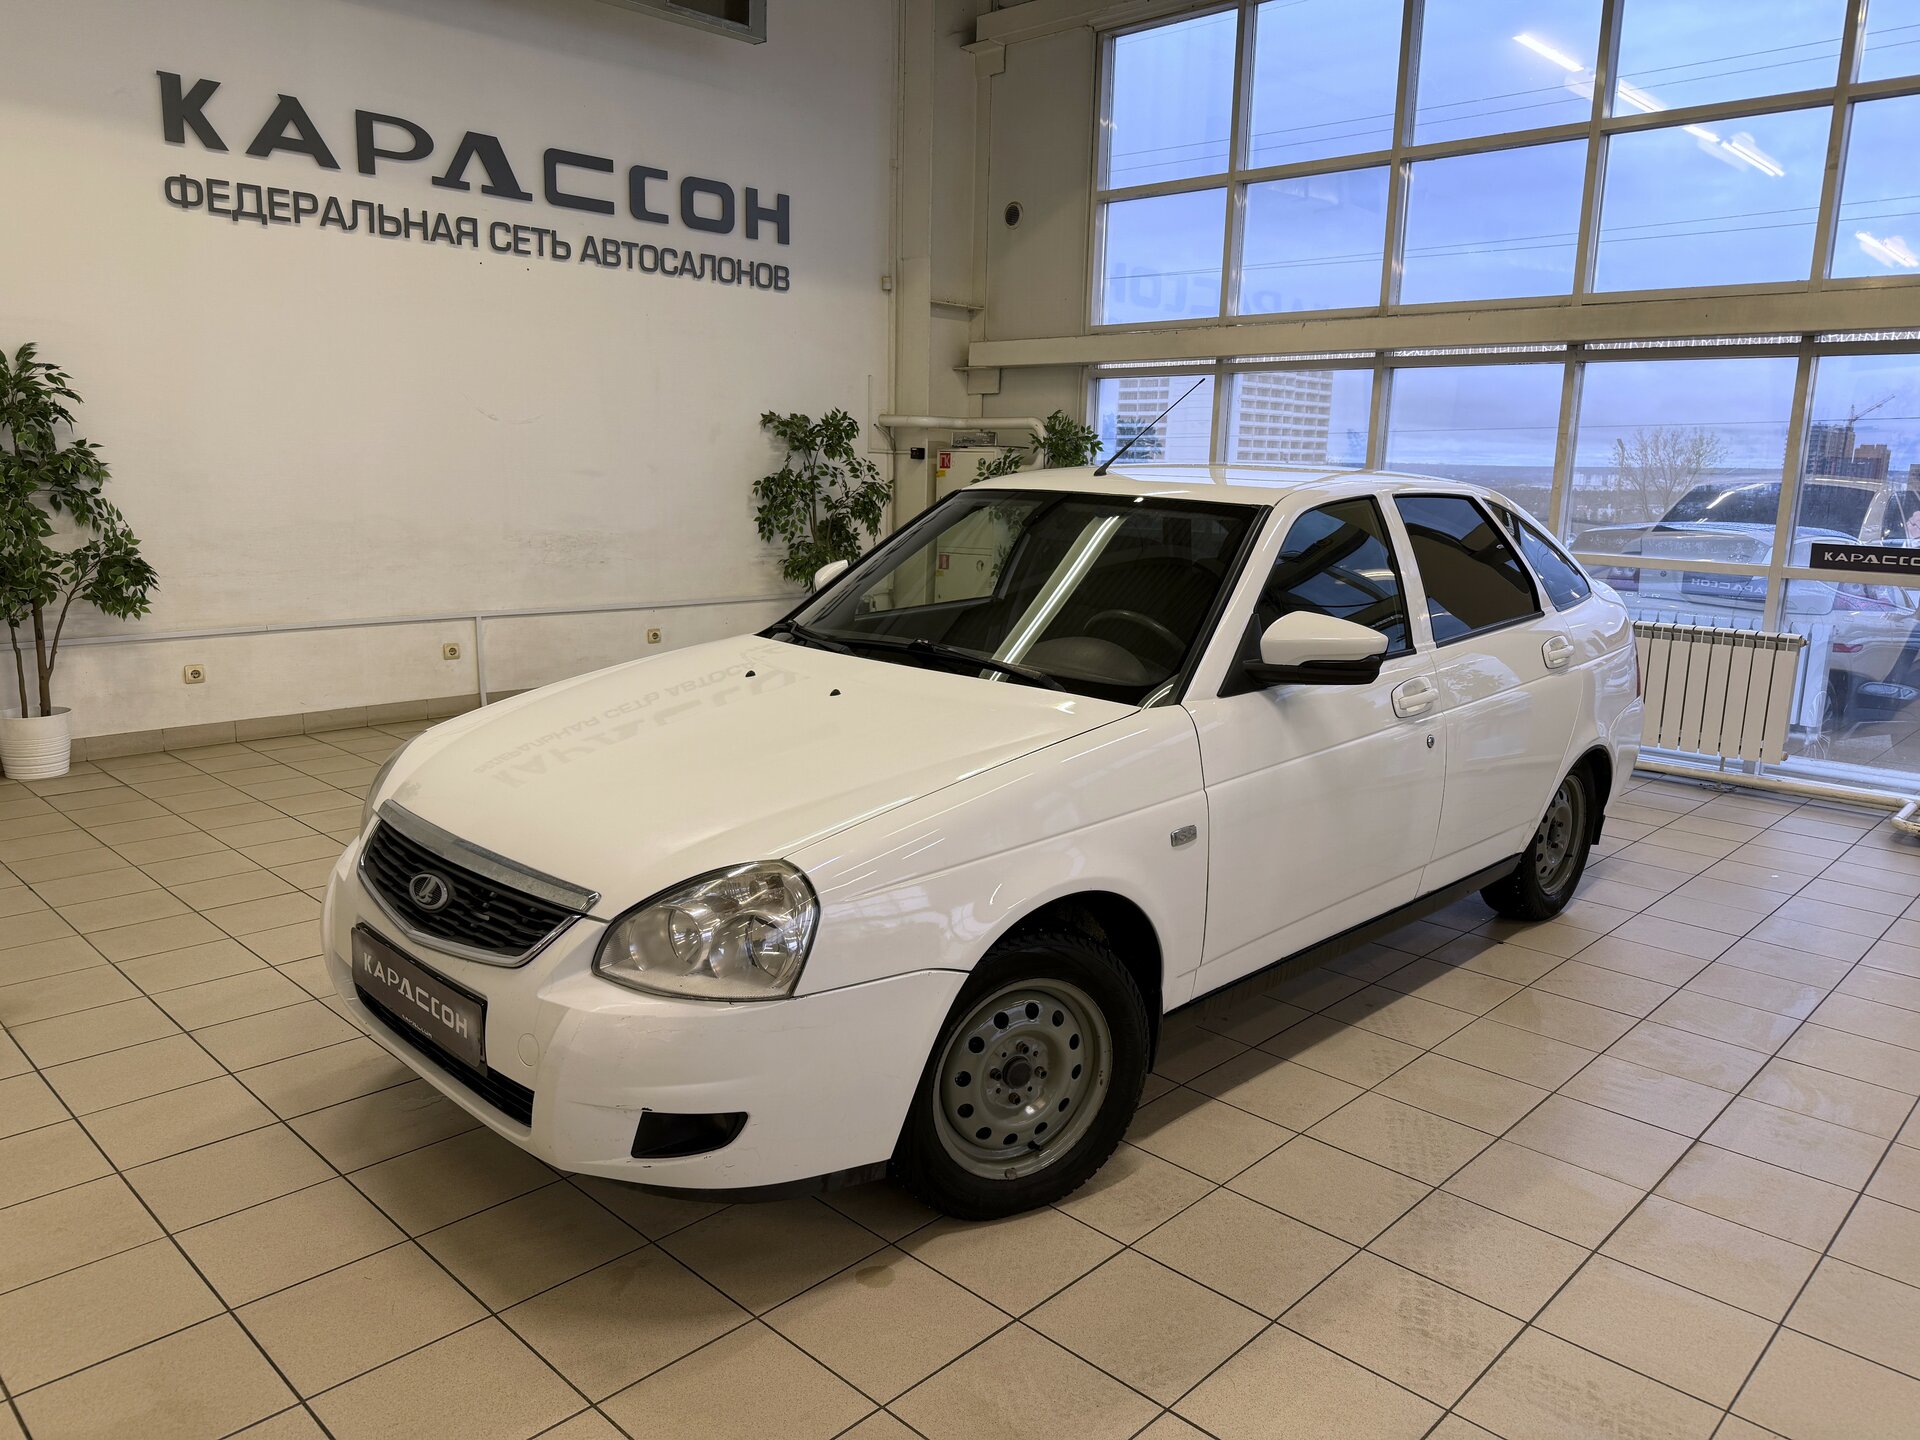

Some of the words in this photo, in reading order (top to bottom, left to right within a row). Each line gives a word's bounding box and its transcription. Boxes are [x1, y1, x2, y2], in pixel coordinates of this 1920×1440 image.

[164, 174, 479, 248] ФЕДЕРАЛЬНАЯ
[489, 221, 572, 260] СЕТЬ
[579, 235, 790, 292] АВТОСАЛОНОВ
